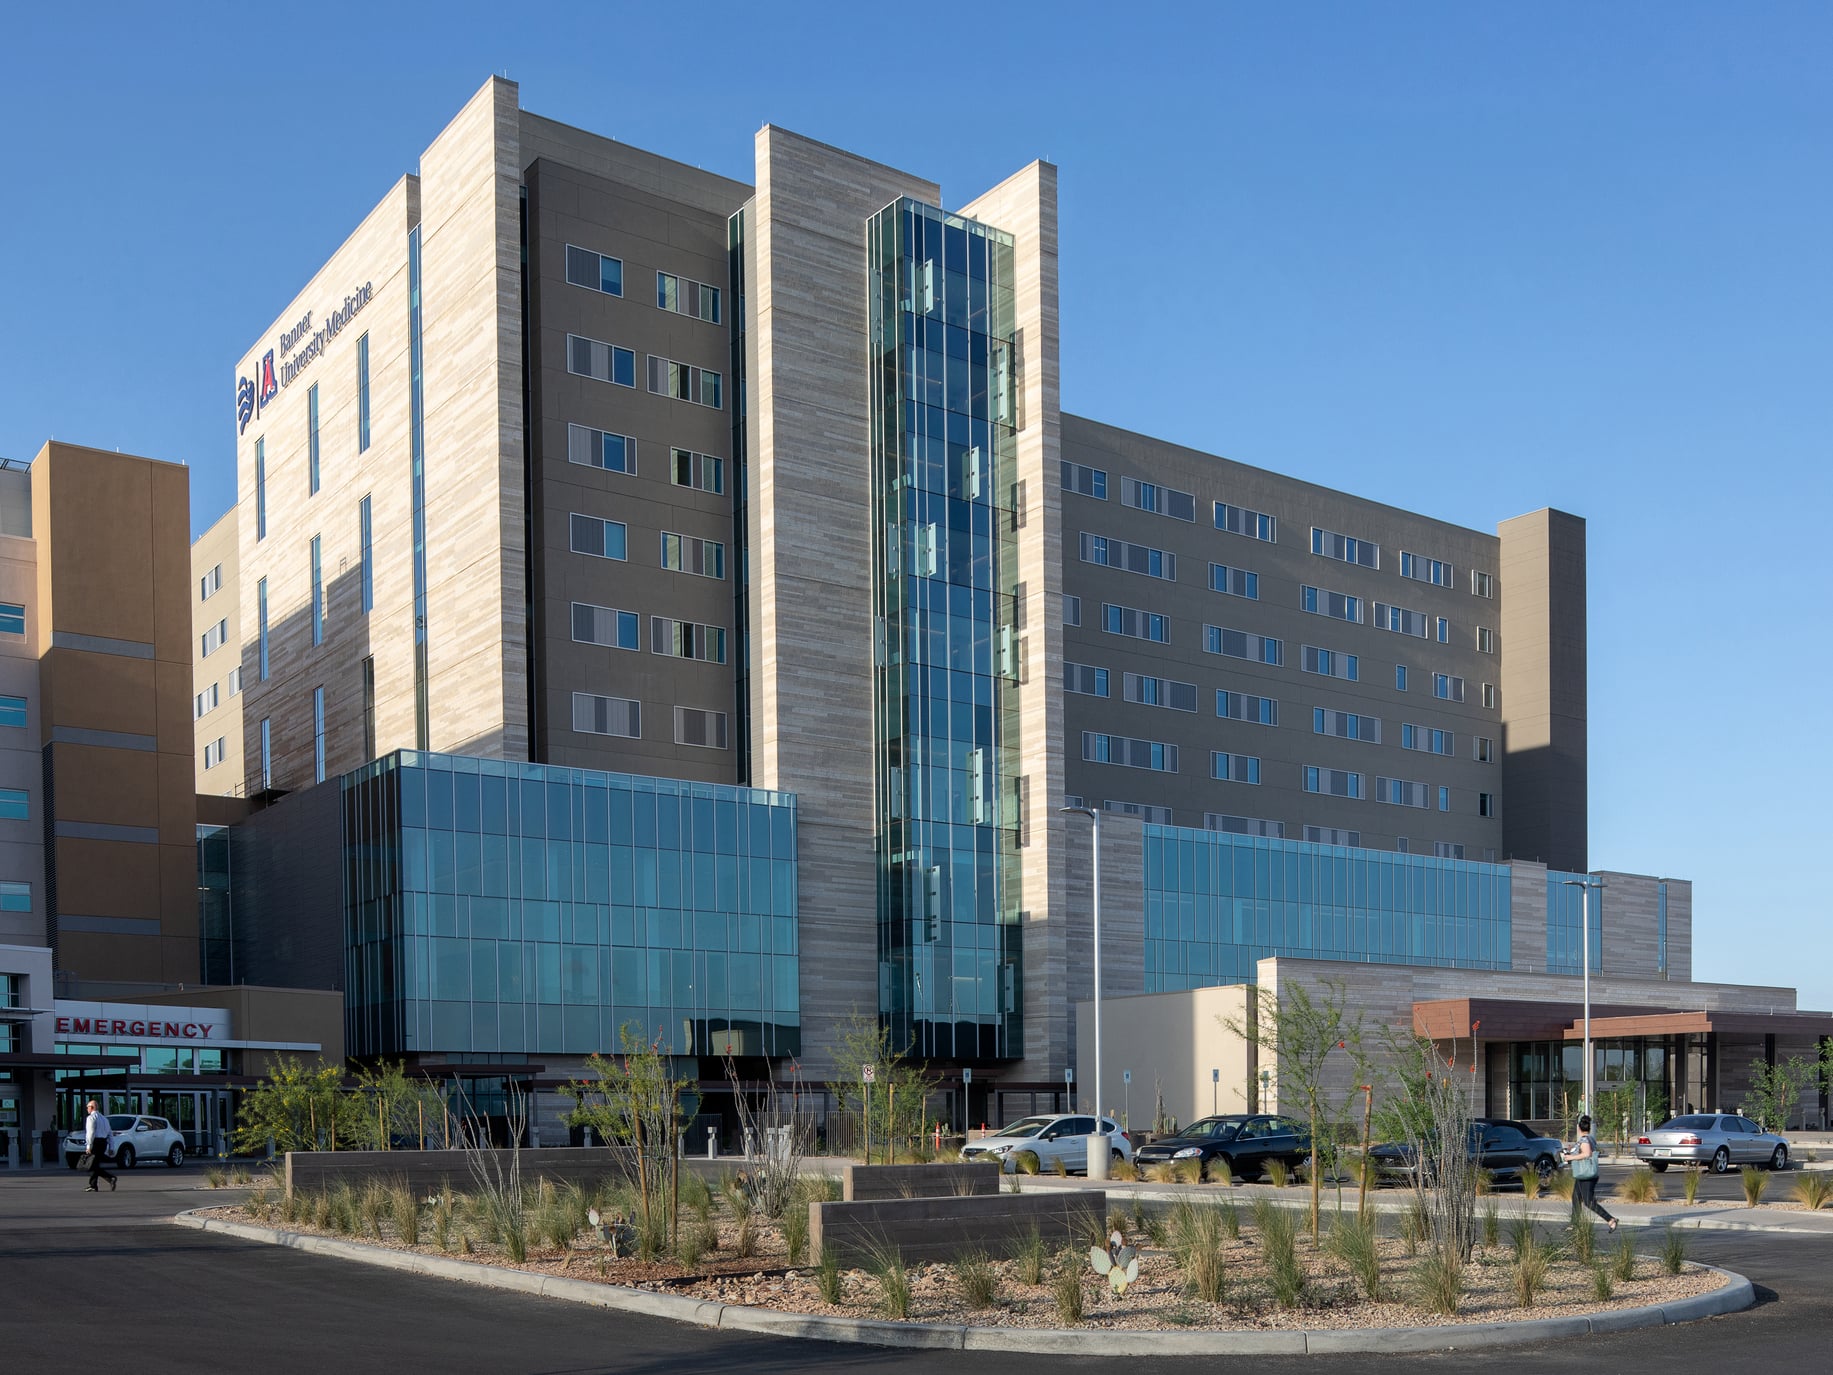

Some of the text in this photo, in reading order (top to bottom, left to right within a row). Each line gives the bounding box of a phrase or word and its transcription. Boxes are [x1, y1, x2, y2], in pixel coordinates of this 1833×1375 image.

[280, 310, 312, 358] Banner
[280, 281, 372, 387] University Medicine
[260, 348, 278, 409] A
[56, 1017, 213, 1038] EMERGENCY
